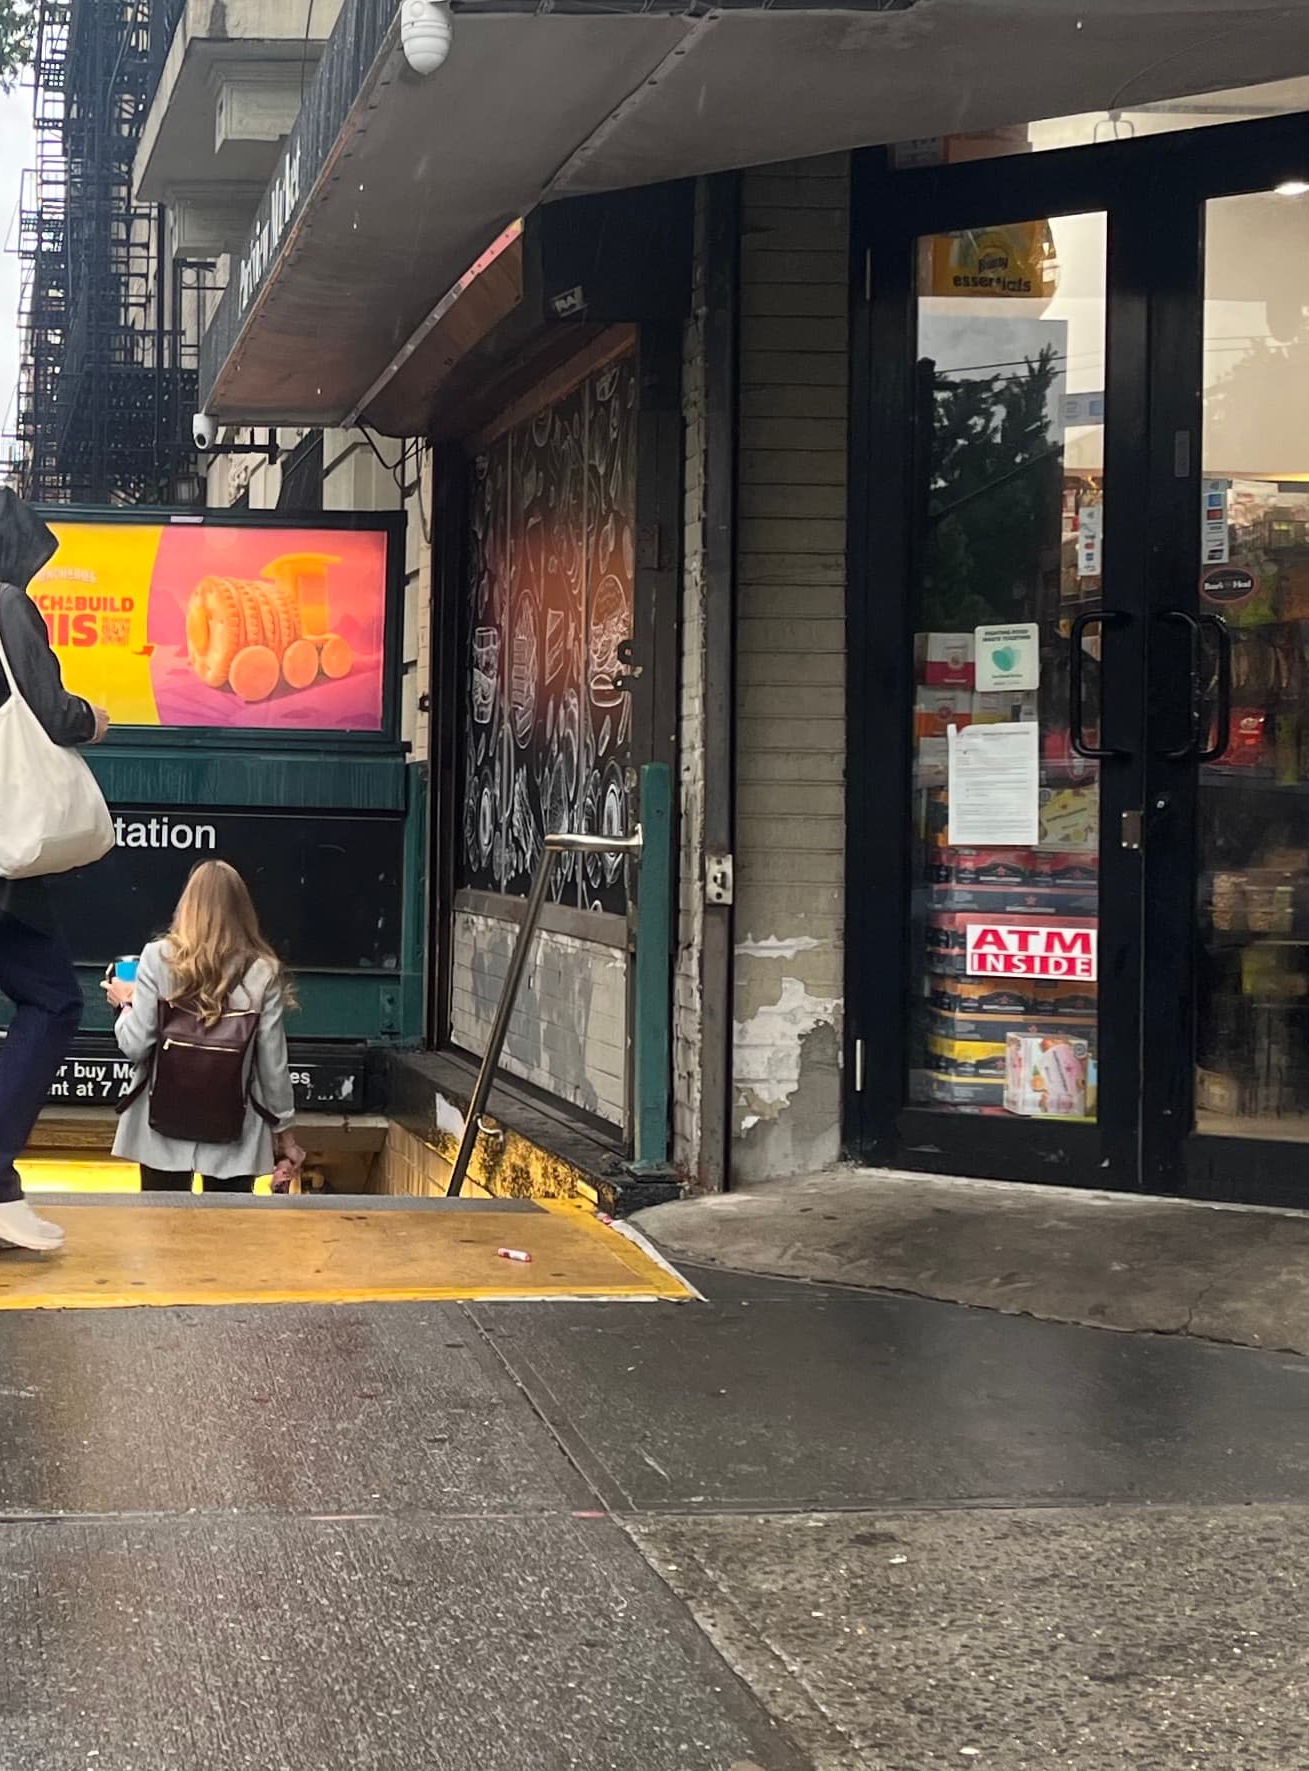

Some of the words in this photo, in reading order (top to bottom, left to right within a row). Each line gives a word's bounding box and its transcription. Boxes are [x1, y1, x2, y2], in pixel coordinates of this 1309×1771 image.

[113, 816, 216, 850] tation
[972, 929, 1091, 955] ATM
[972, 953, 1091, 977] INSIDE
[74, 1062, 106, 1082] buy
[290, 1072, 311, 1085] es
[50, 1081, 70, 1096] nt
[76, 1082, 94, 1097] at
[100, 1081, 112, 1097] 7
